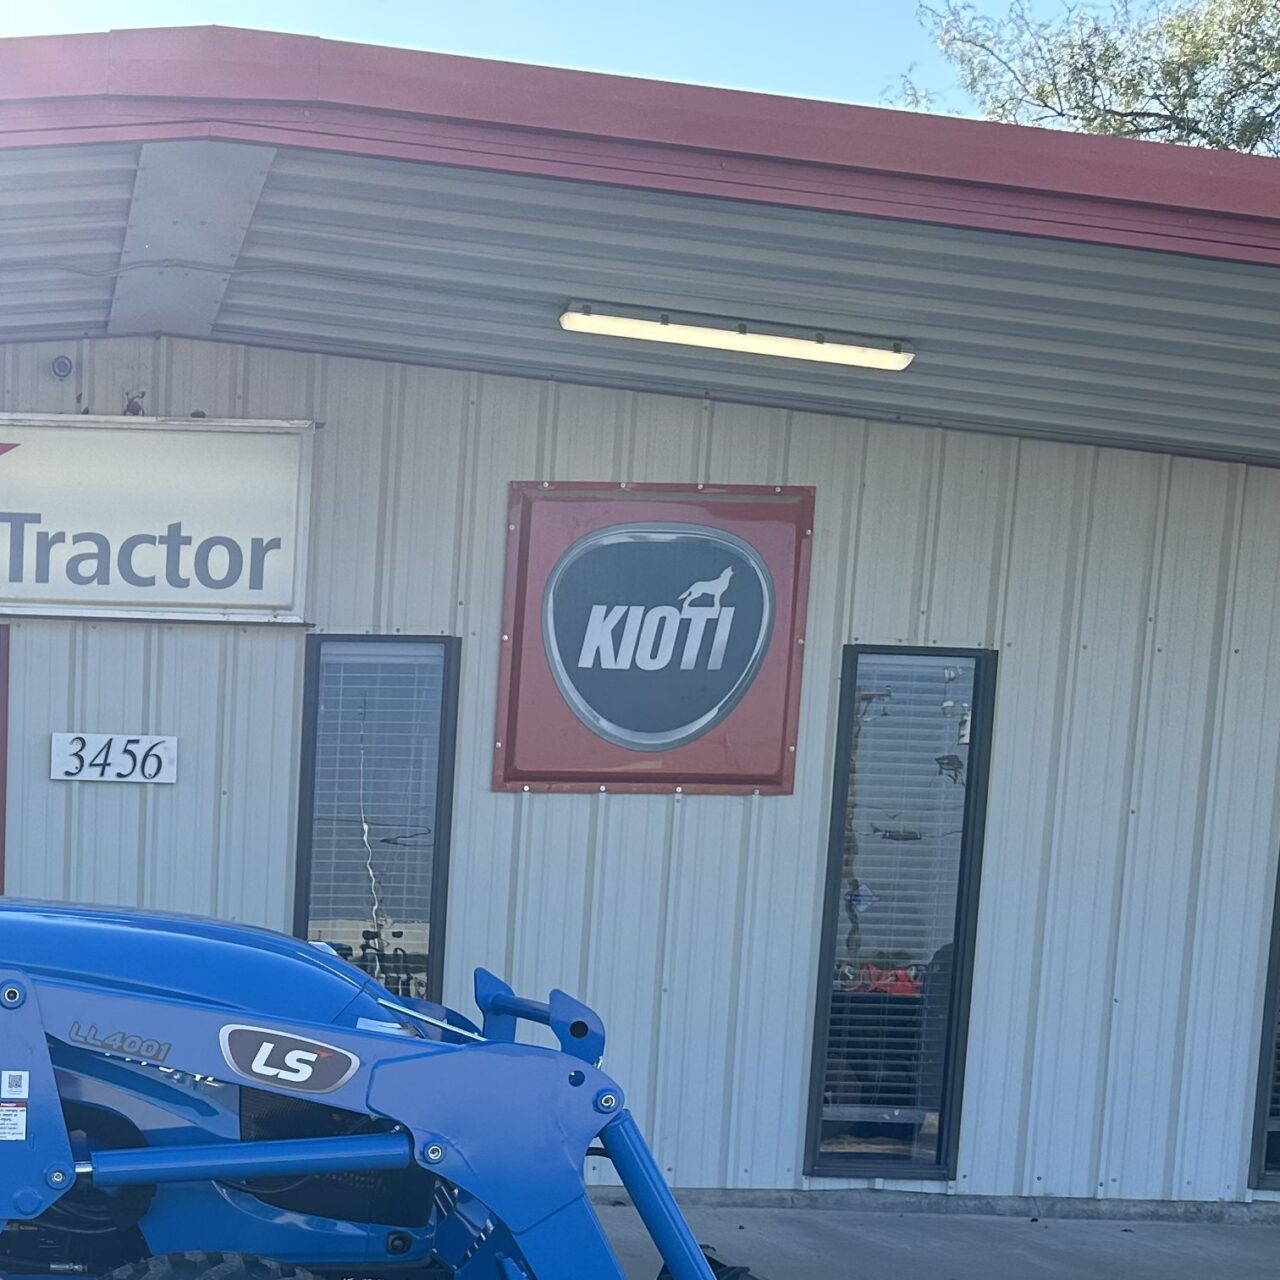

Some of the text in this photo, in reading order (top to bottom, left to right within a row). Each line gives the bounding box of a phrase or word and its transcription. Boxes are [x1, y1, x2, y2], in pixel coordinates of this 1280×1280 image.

[577, 604, 735, 671] KIOTI
[64, 736, 167, 780] 3456
[69, 1020, 172, 1062] LL4001
[251, 1041, 318, 1082] LS
